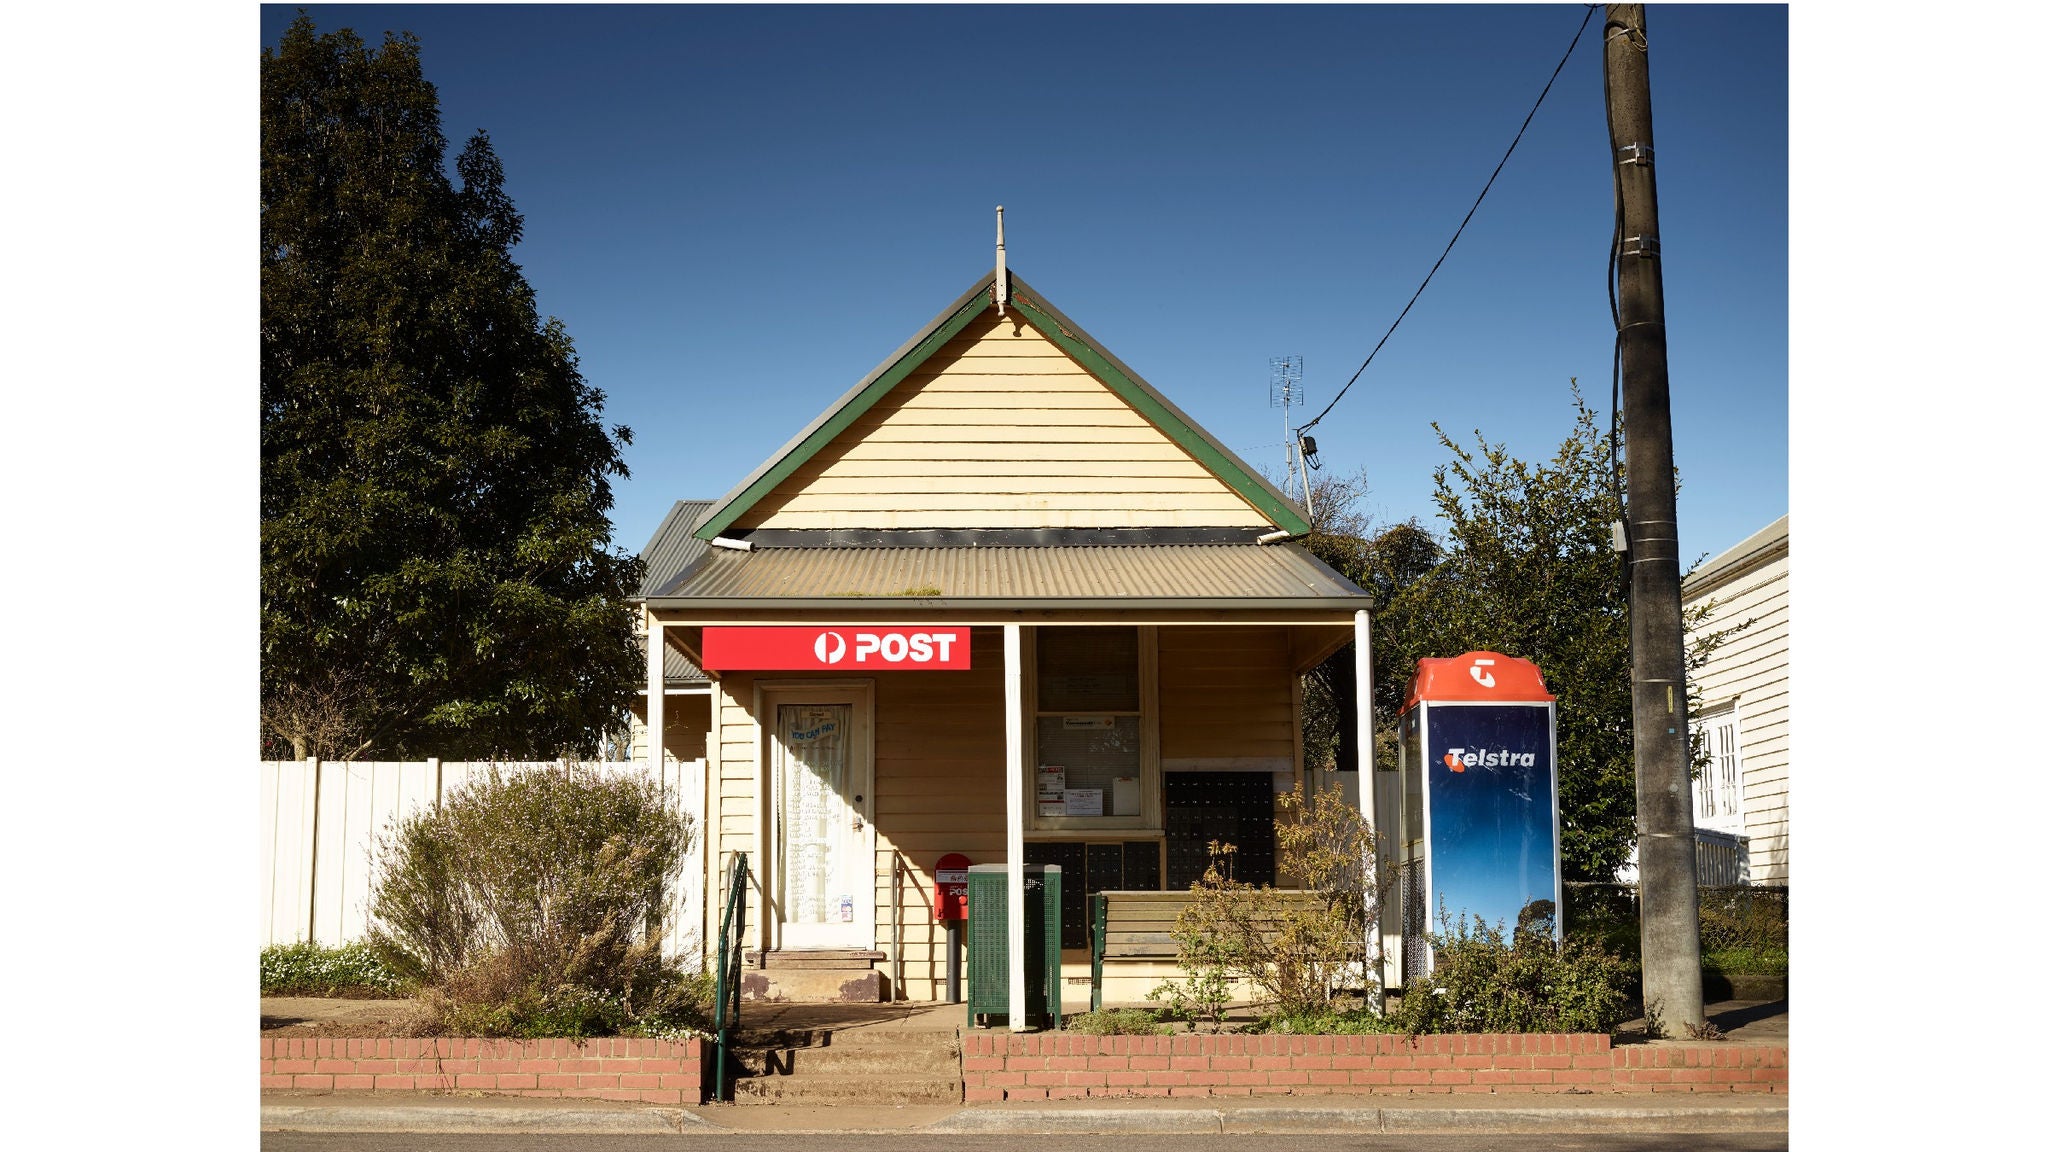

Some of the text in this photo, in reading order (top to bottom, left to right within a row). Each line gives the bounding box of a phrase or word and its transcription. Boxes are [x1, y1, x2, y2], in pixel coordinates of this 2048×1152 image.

[856, 633, 956, 662] POST
[791, 723, 835, 740] YOU CAN PAY
[1447, 748, 1535, 767] Telstra
